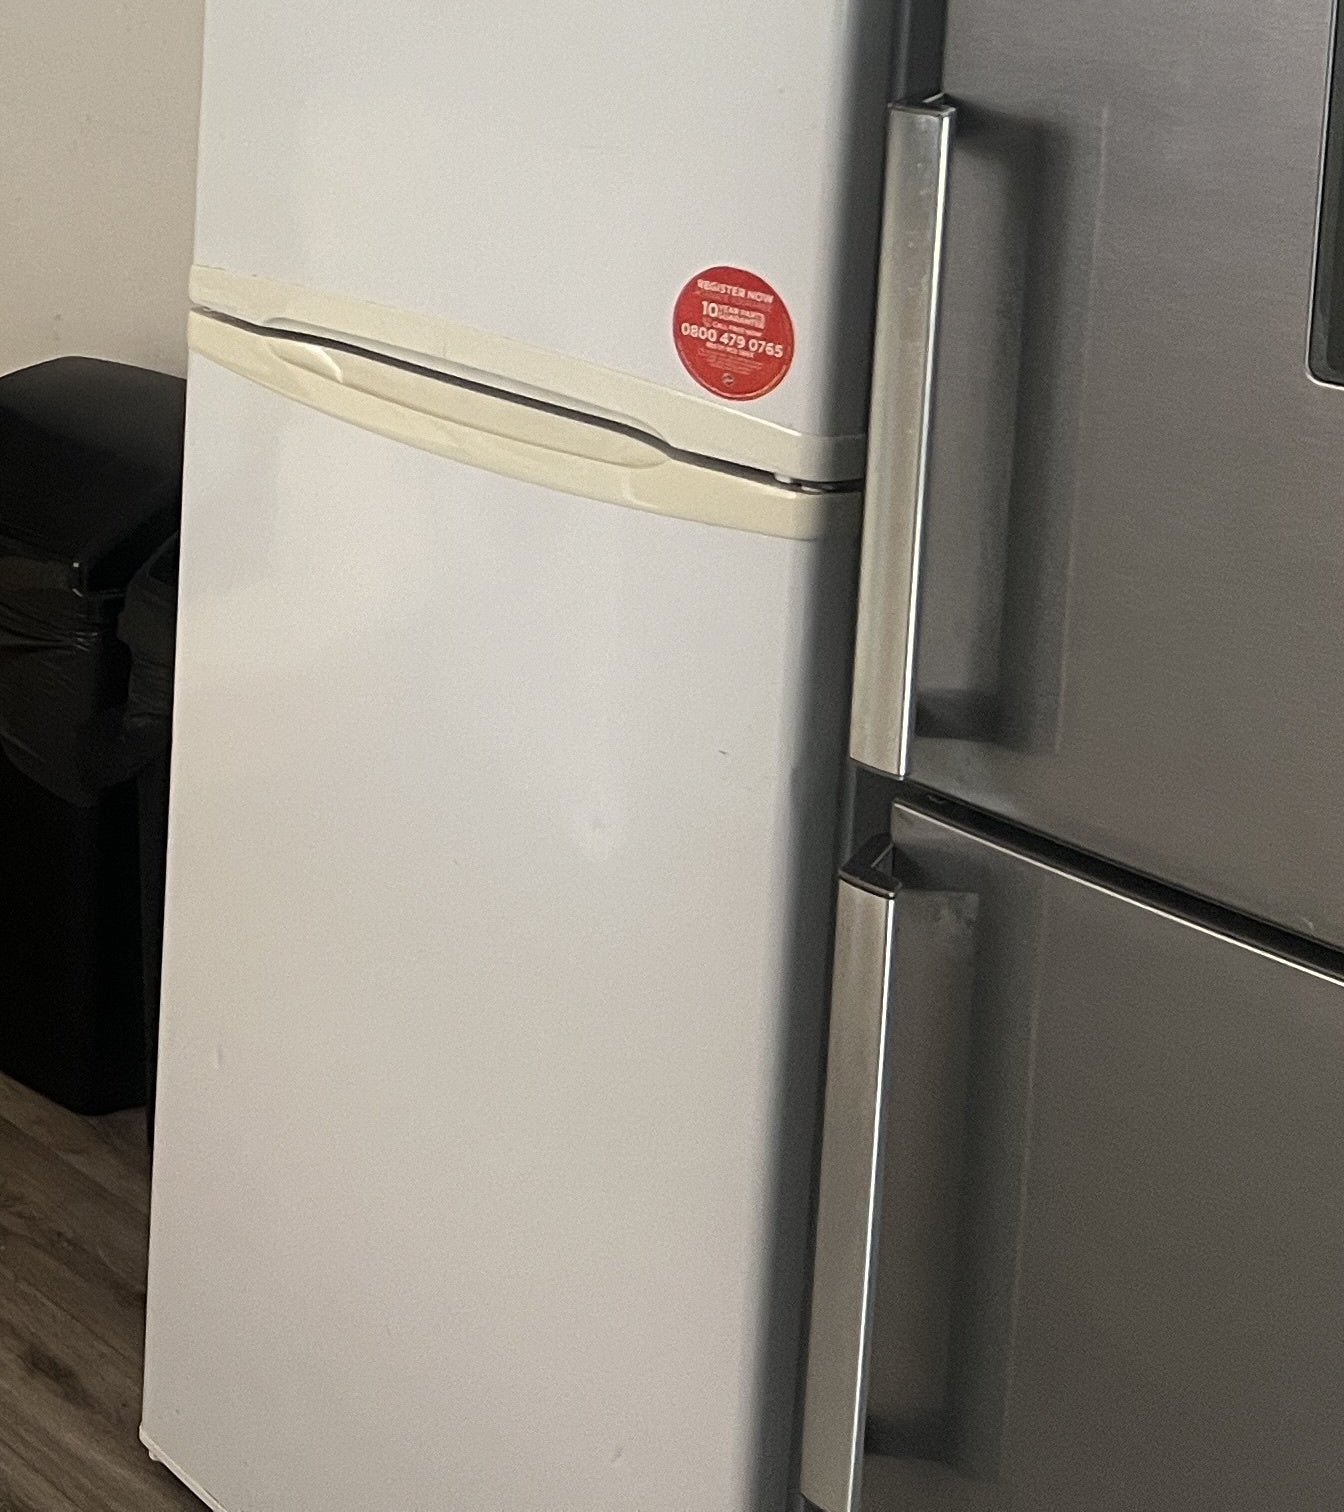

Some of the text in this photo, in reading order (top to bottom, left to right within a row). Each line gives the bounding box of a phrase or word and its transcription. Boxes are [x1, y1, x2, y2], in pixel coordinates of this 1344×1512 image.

[697, 278, 774, 304] REGISTER NOW
[701, 301, 719, 318] 10
[681, 322, 718, 342] 0800
[720, 332, 745, 349] 479
[748, 338, 784, 358] 0765
